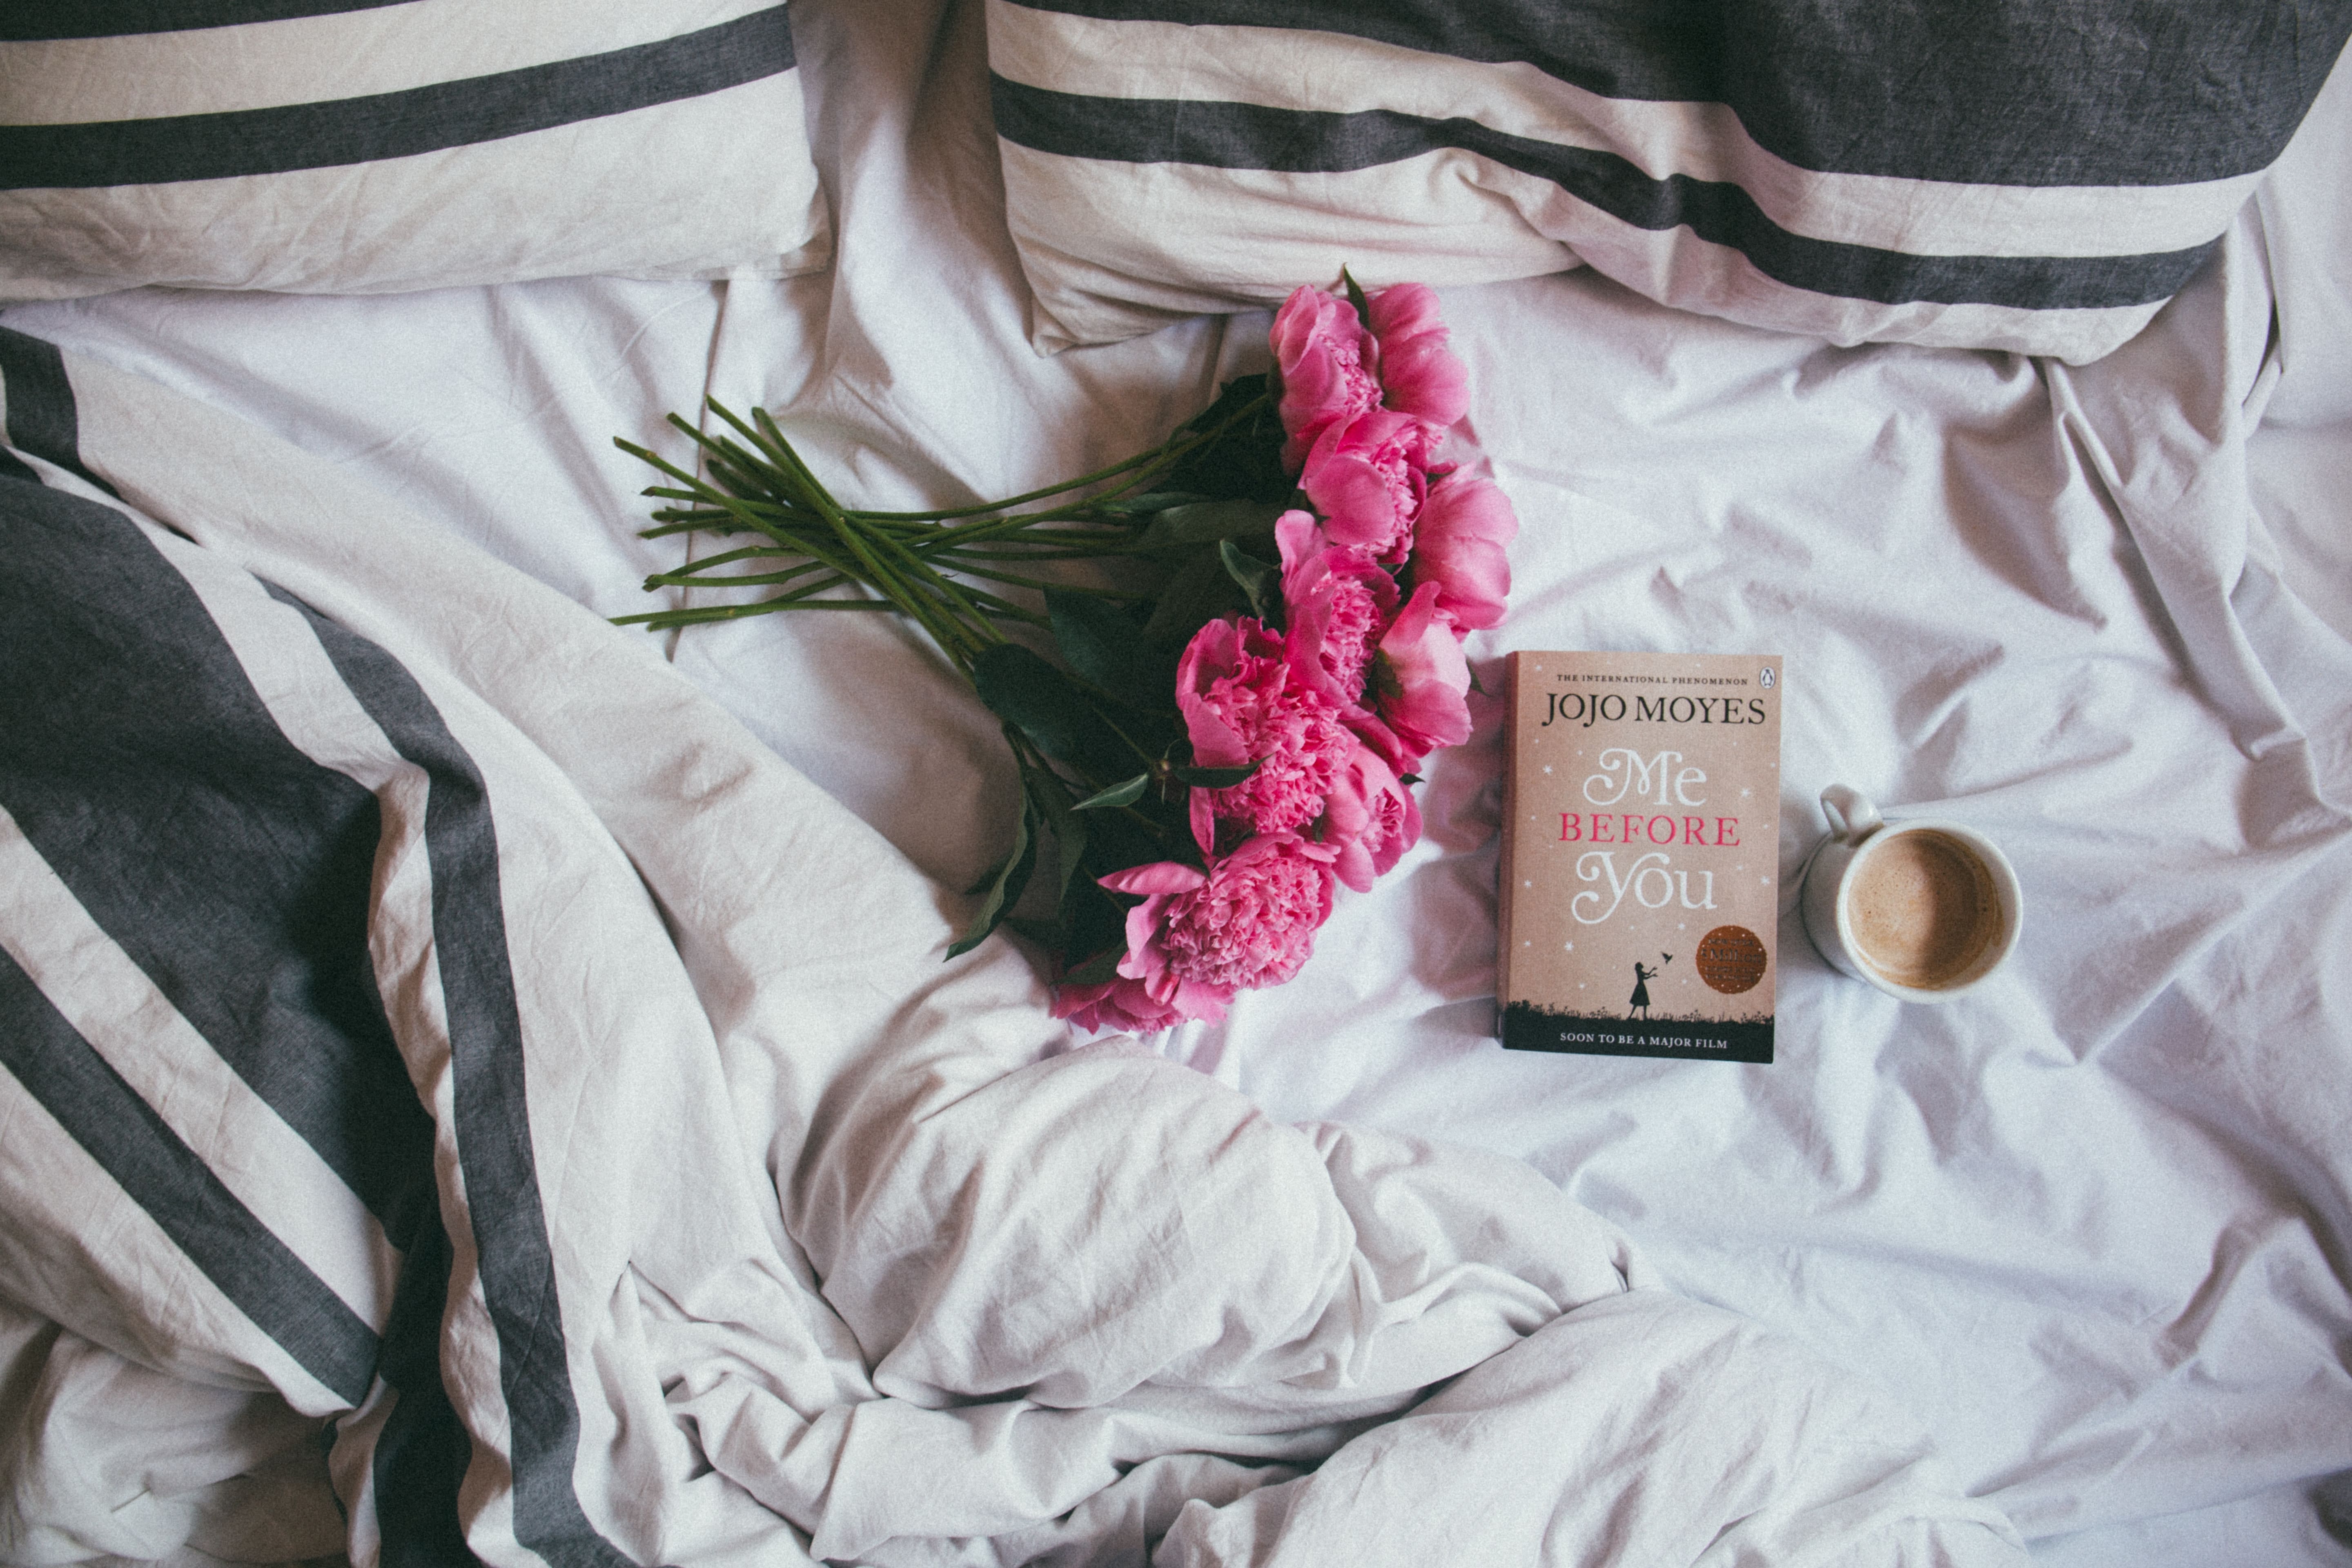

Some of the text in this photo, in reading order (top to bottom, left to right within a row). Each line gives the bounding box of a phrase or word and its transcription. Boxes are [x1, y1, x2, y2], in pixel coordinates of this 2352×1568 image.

[1582, 675, 1668, 684] INTERNATIONAL
[1672, 677, 1748, 685] PHENOMENON
[1541, 693, 1766, 728] JOJO MOYES
[1583, 748, 1707, 806] Me
[1559, 813, 1740, 846] BEFORE
[1572, 851, 1717, 924] You
[1561, 1033, 1727, 1049] SOON TO BE A MAJOR FILM
